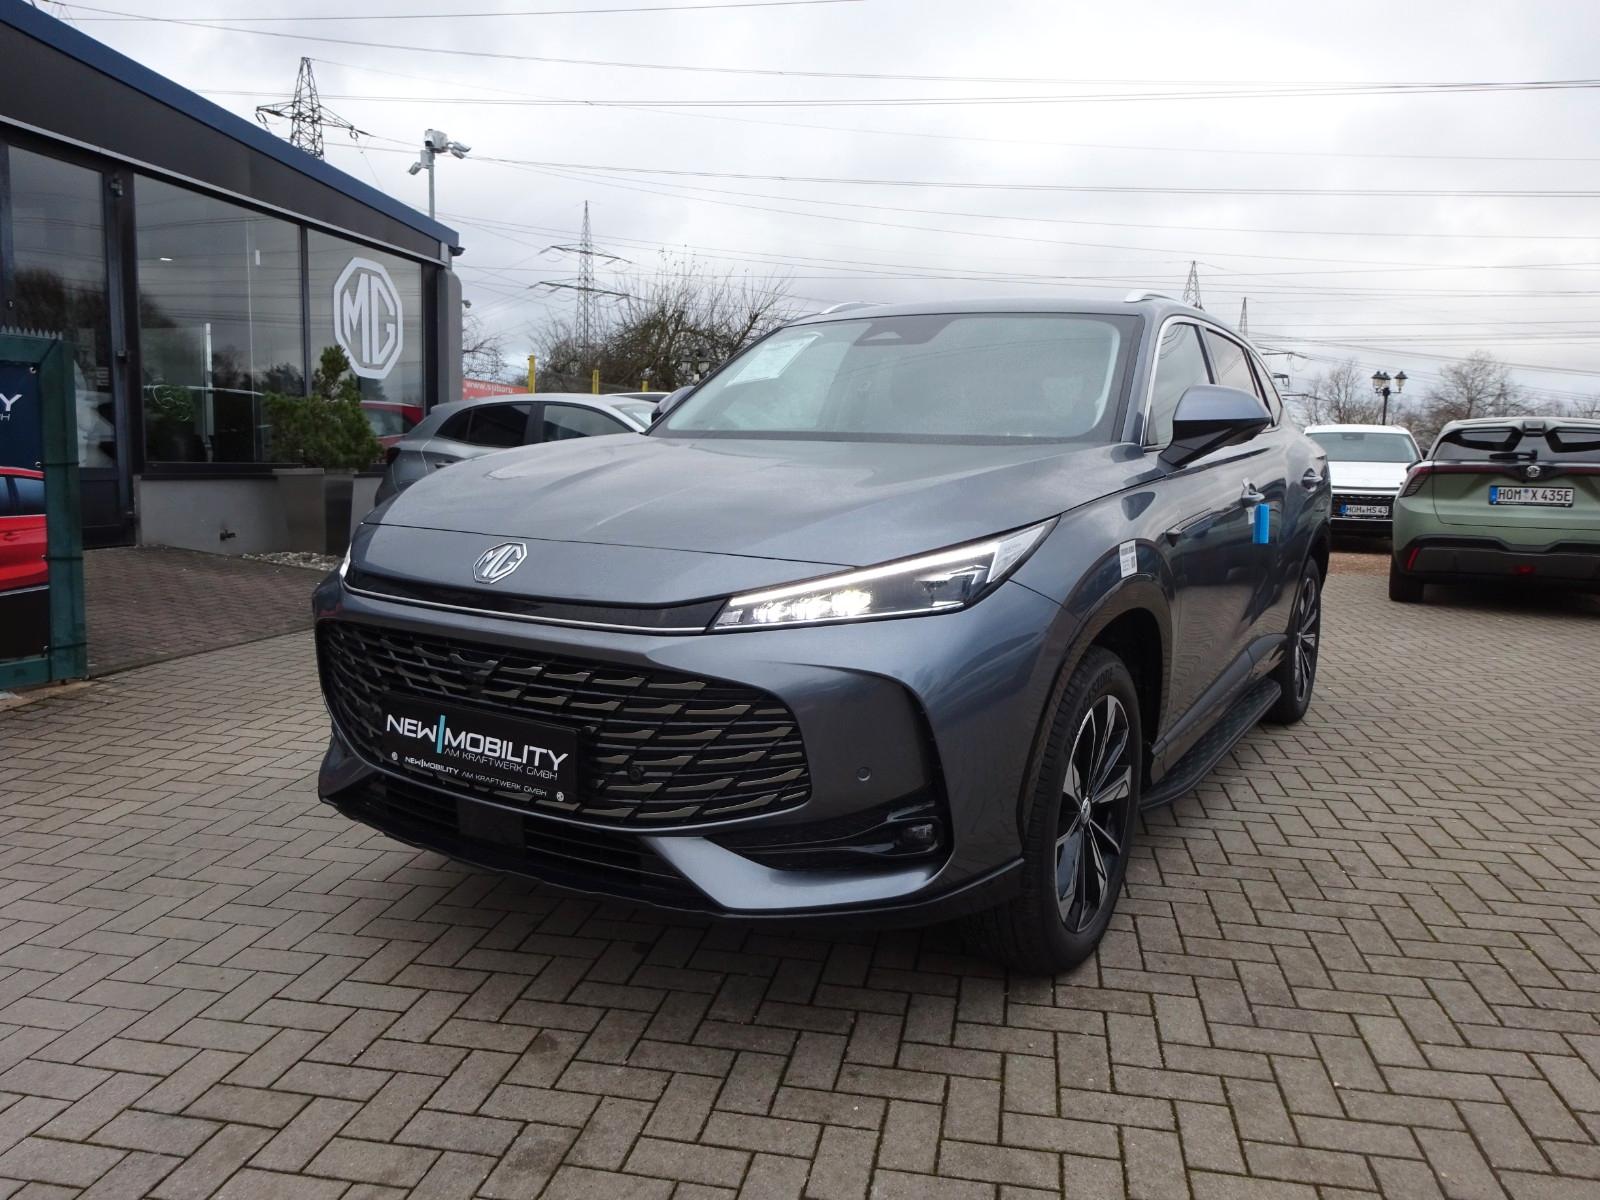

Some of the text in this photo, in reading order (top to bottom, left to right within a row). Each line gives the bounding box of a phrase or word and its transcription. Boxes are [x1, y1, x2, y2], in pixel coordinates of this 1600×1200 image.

[341, 270, 397, 366] MG
[1498, 488, 1572, 502] HOM X 435E
[476, 544, 523, 580] MG
[444, 727, 569, 771] MOBILITY
[444, 748, 558, 781] AM KRAFTWERK GMBH
[461, 771, 474, 779] AM
[475, 774, 522, 791] KRAFTWERK
[523, 785, 548, 797] GMBH
